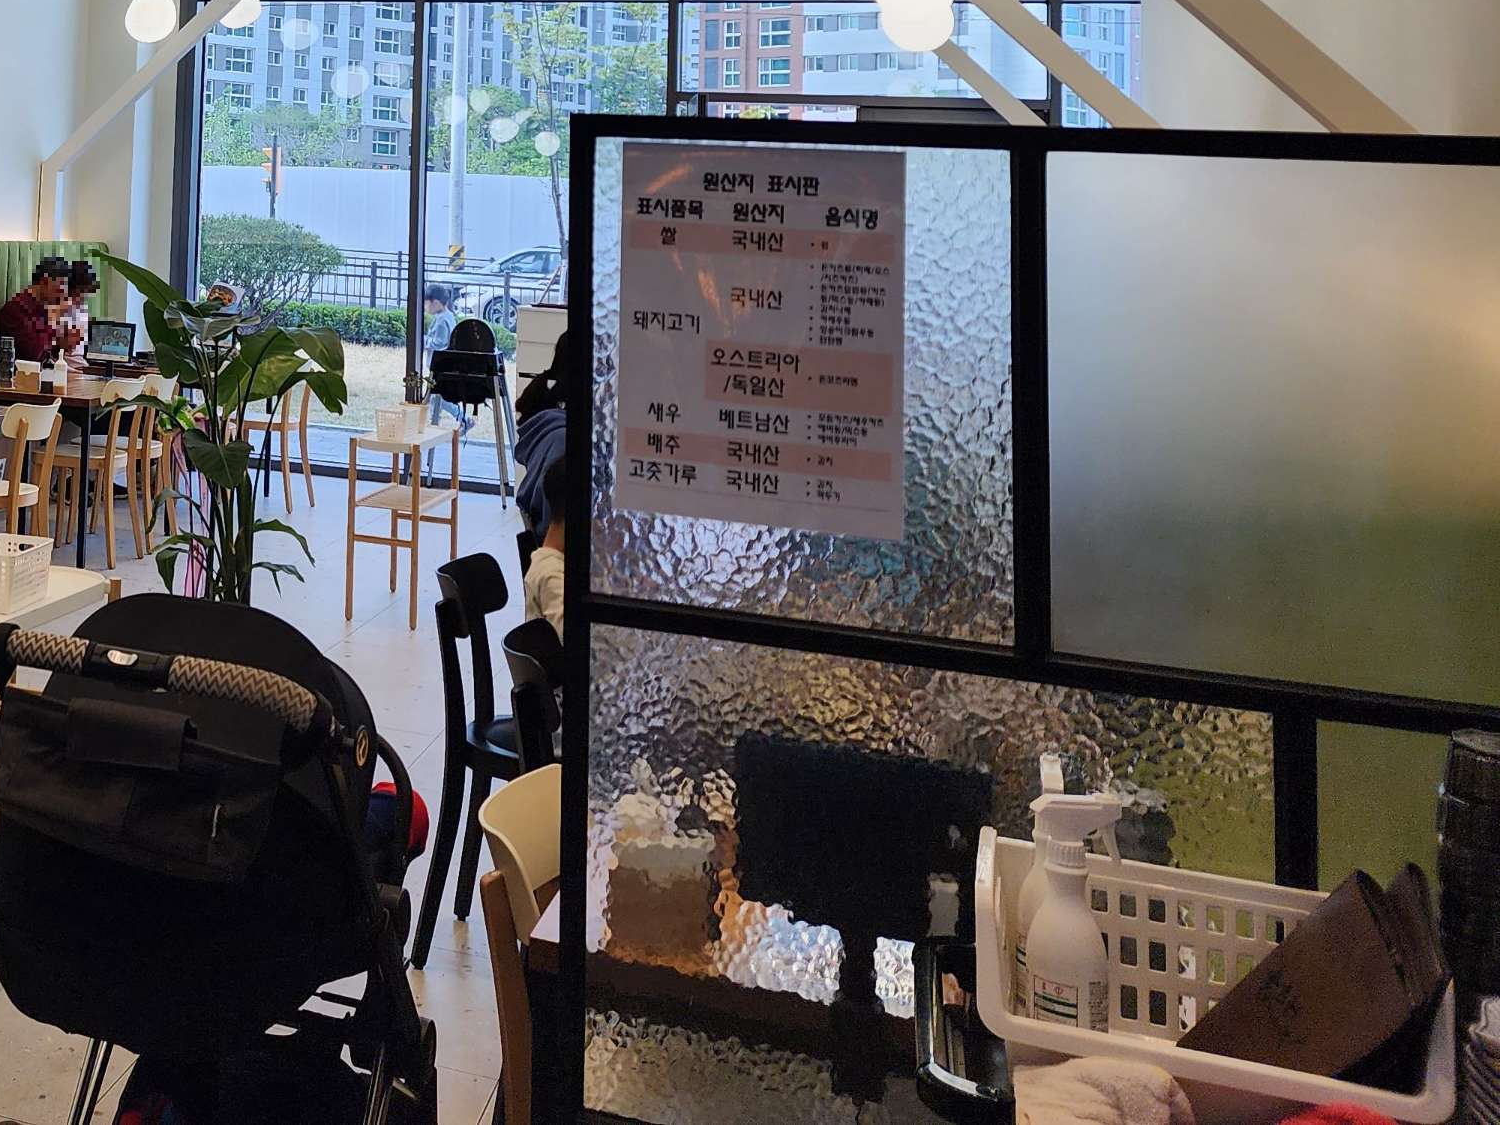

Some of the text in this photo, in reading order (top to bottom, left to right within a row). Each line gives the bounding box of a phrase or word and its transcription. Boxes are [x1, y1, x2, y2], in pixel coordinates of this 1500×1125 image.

[703, 173, 819, 197] 원산지 표시판
[637, 198, 703, 219] 표시품목
[733, 203, 784, 223] 원산지
[825, 207, 879, 229] 음식명
[660, 226, 677, 245] 쌀
[733, 230, 784, 252] 국내산
[731, 288, 783, 309] 국내산
[633, 311, 700, 334] 돼지고기
[711, 349, 800, 374] 오스트리아
[724, 375, 785, 398] /독일산
[648, 404, 681, 425] 새우
[719, 409, 790, 434] 베트남산
[647, 432, 681, 455] 배추
[728, 442, 780, 466] 국내산
[629, 459, 697, 485] 고춧가루
[727, 470, 779, 495] 국내산
